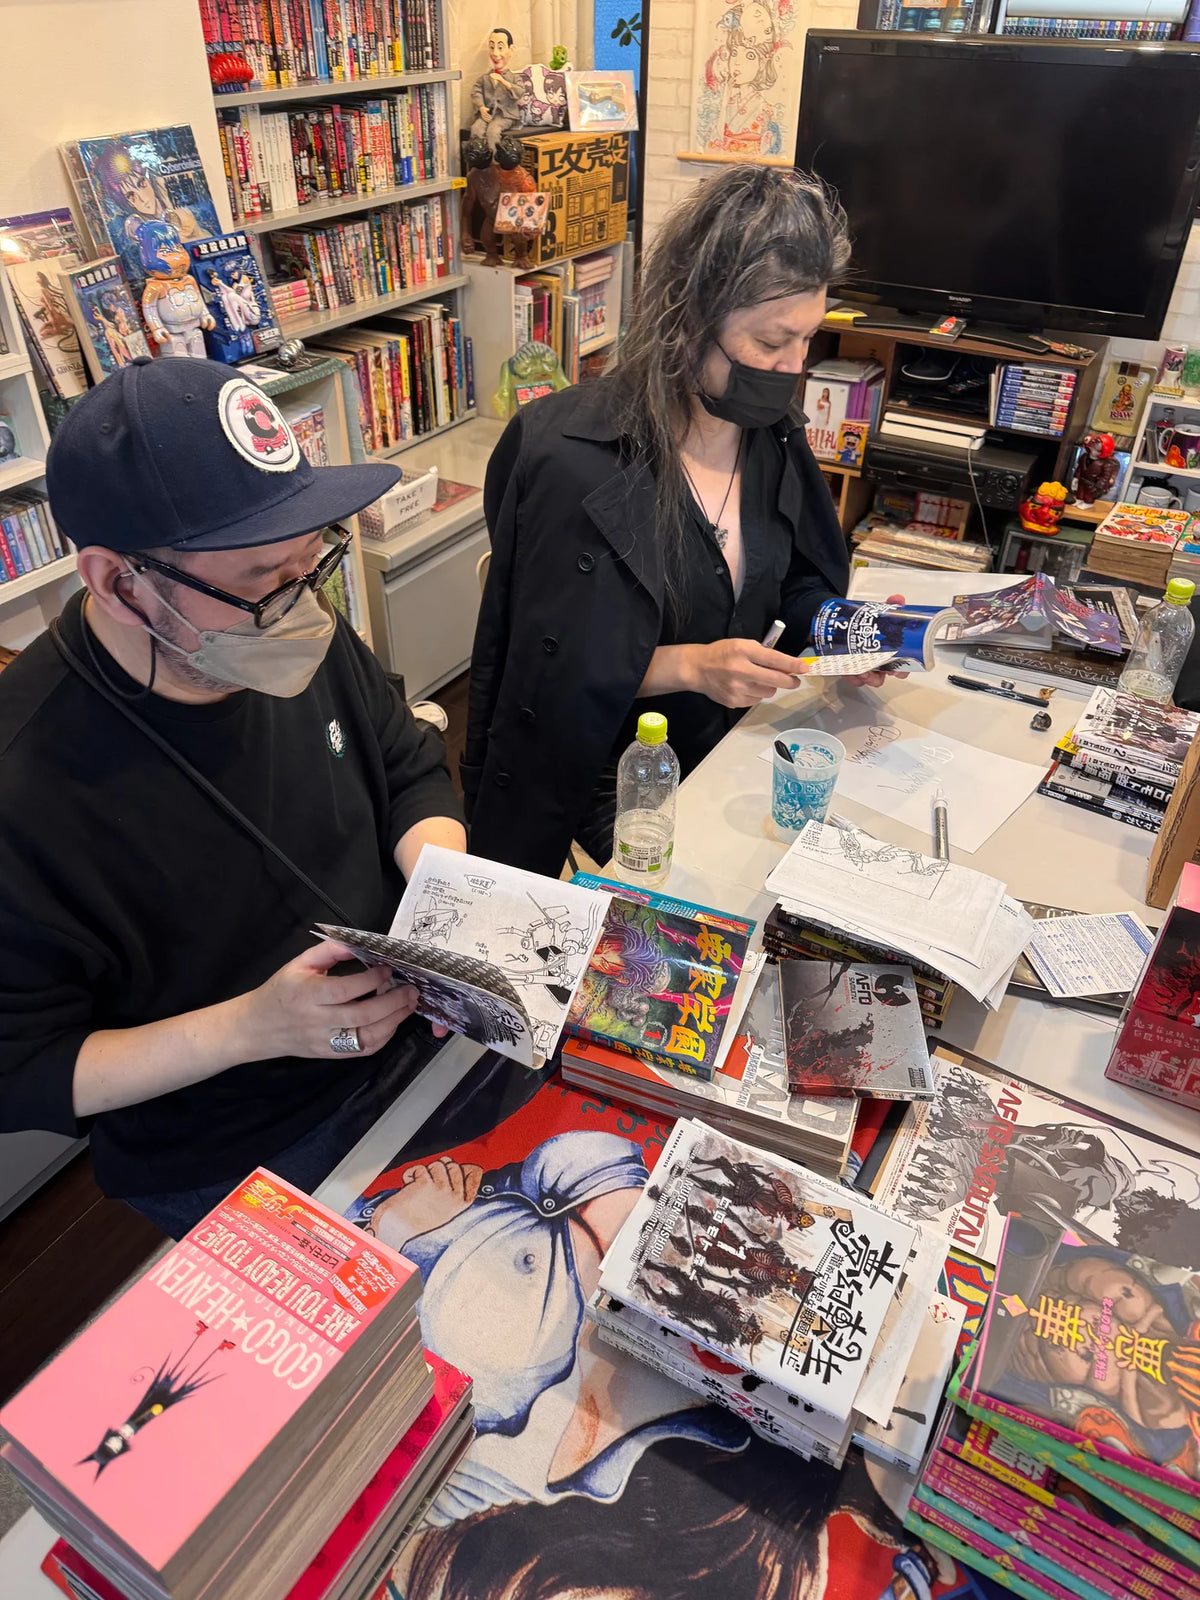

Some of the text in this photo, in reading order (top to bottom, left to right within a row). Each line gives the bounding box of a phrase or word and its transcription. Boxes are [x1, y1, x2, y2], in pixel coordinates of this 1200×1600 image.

[541, 139, 629, 179] 攻殻
[1110, 409, 1132, 420] RAW
[394, 490, 418, 504] TAKE
[397, 499, 422, 515] FREE
[833, 619, 848, 630] 2
[1136, 720, 1157, 732] 2
[1113, 747, 1126, 757] 2
[1122, 765, 1136, 775] 2
[951, 1141, 1006, 1248] SAMURAI
[288, 1231, 340, 1268] ヒロモト森一
[688, 1197, 732, 1281] ヒロモト森一
[152, 1251, 238, 1327] HEAVEN
[191, 1218, 360, 1346] ARE YOU READY TO DIE?
[355, 1256, 390, 1292] アニメーション
[795, 1216, 901, 1385] 夢幻転生
[1028, 1295, 1167, 1384] 悪ノ華
